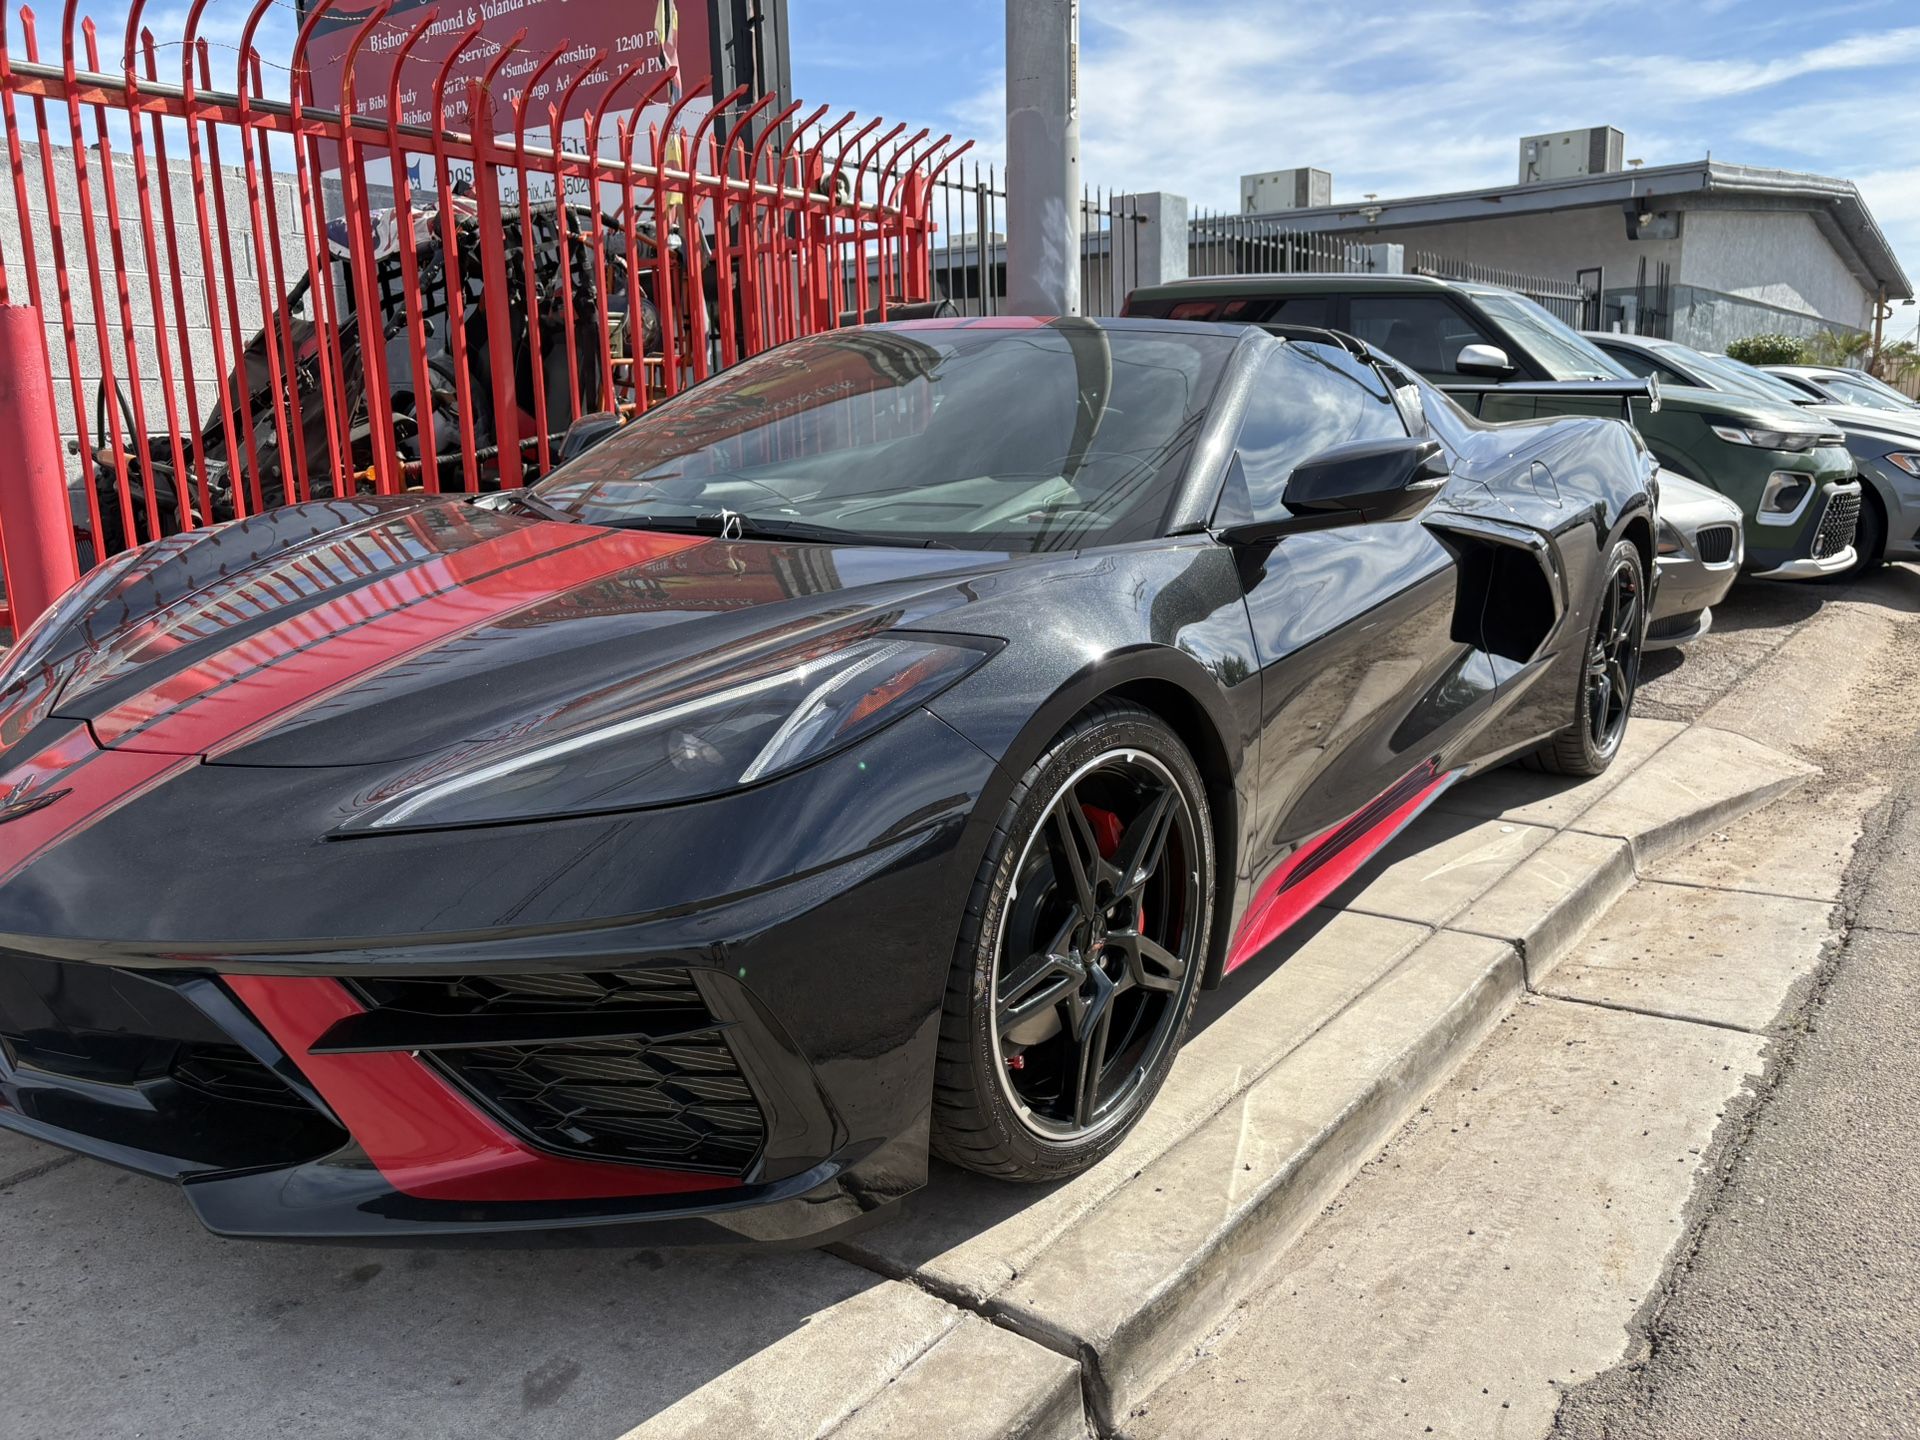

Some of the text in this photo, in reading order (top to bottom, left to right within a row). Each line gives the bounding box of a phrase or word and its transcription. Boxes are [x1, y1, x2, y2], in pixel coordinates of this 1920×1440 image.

[411, 10, 463, 43] ymond
[466, 7, 477, 25] &
[458, 42, 501, 63] Services
[616, 34, 643, 53] 12:00
[508, 83, 549, 102] Dongo
[556, 67, 608, 92] Adación
[369, 94, 386, 110] Bibl
[400, 88, 417, 105] udy
[504, 180, 542, 201] Phonix,
[976, 847, 1014, 972] MICHELIN
